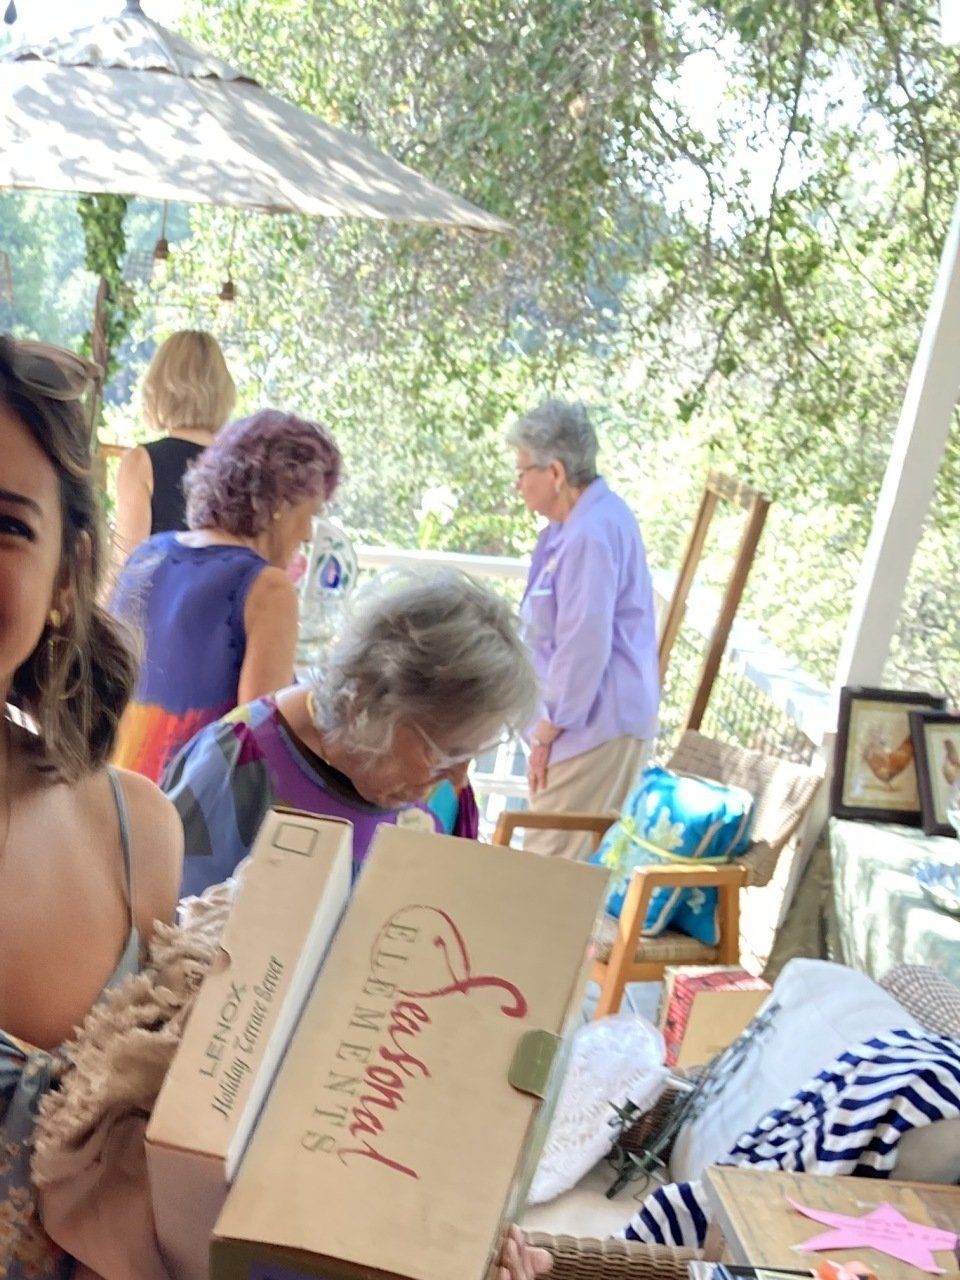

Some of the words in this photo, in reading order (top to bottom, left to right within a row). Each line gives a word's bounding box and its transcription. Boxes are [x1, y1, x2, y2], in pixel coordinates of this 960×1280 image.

[199, 982, 246, 1078] LENOX
[211, 1056, 253, 1121] Holiday
[233, 1000, 269, 1055] Terrace
[253, 955, 285, 1001] Server
[301, 921, 420, 1154] ELEMENTS
[337, 904, 527, 1180] Seasonal
